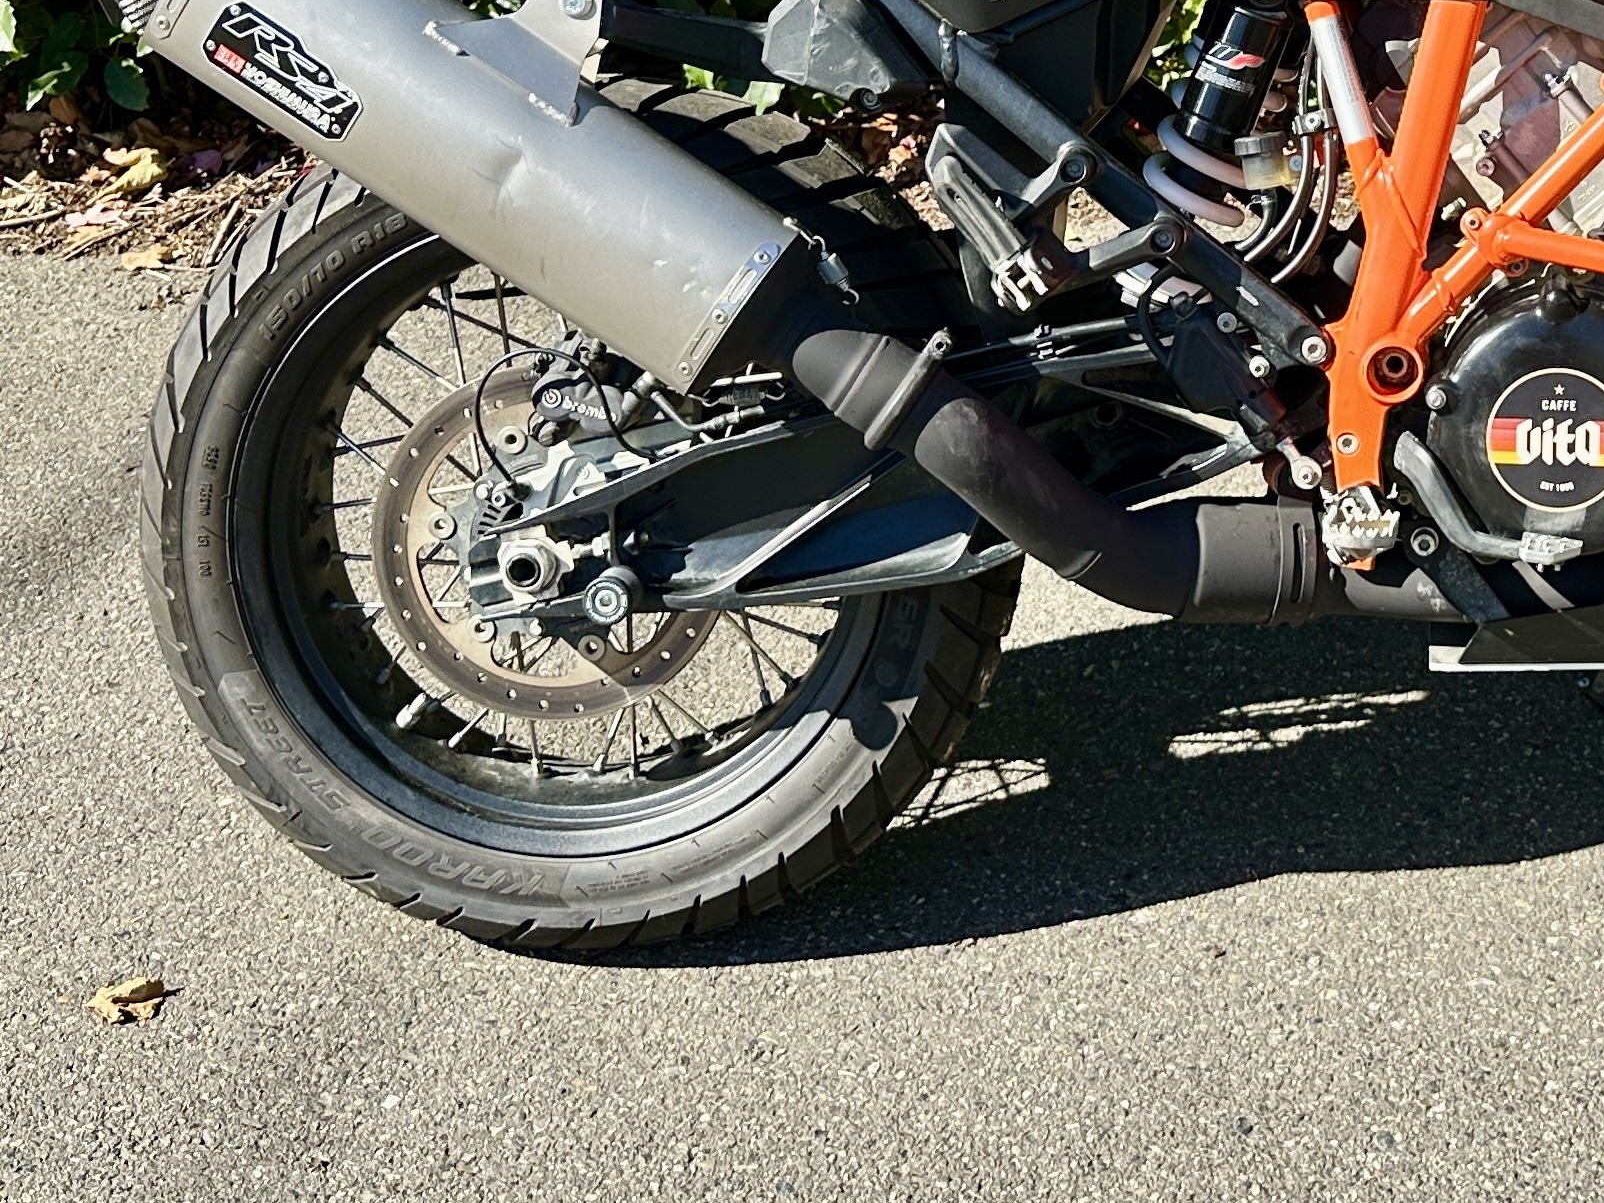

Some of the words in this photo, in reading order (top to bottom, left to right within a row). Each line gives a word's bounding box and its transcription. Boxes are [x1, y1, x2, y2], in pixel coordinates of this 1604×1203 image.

[258, 249, 345, 341] 150/70
[351, 211, 408, 254] R18
[1541, 398, 1577, 412] CAFFE
[239, 696, 351, 813] STREET
[360, 825, 546, 896] KAROO
